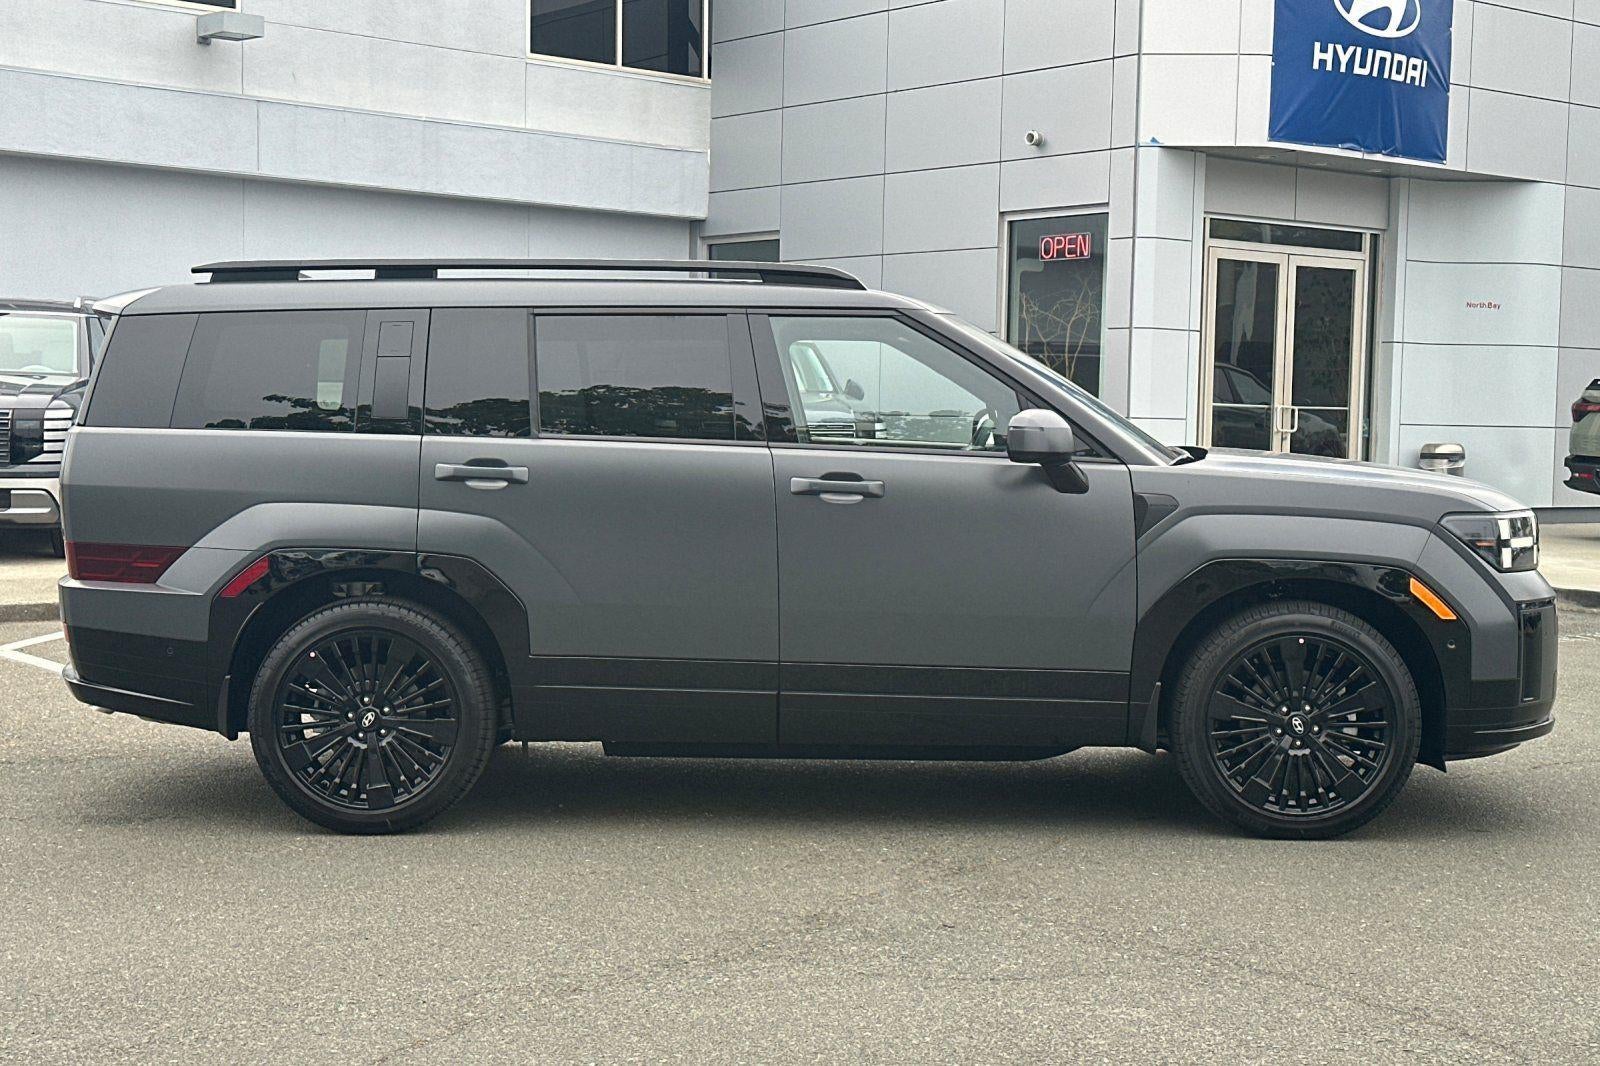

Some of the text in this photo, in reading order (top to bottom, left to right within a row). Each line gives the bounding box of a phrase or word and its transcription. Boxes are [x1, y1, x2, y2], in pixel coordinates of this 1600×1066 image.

[1312, 41, 1428, 88] HYUNDAI
[1041, 234, 1089, 259] OPEN
[1466, 301, 1501, 310] North Bay
